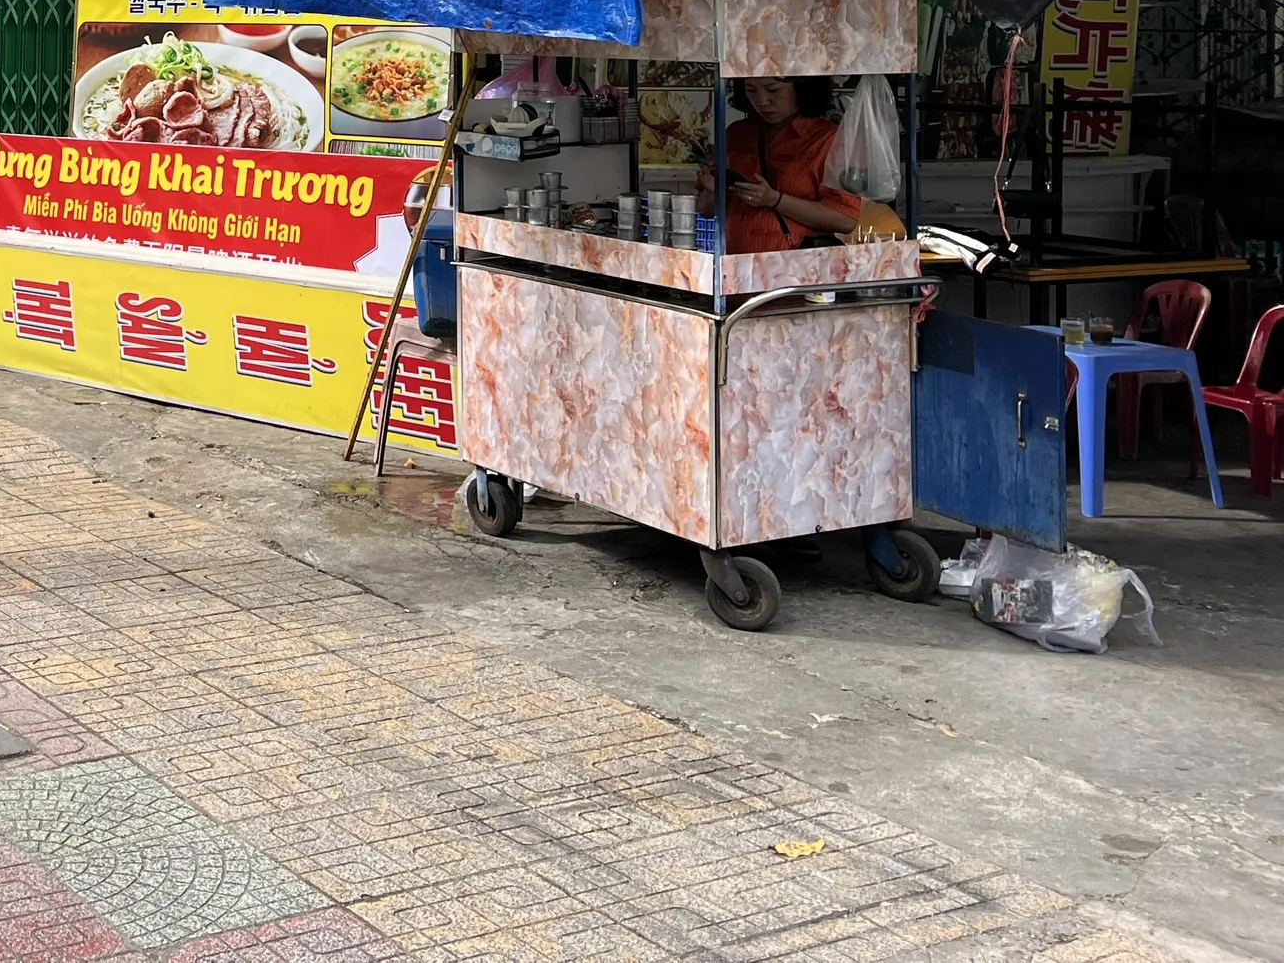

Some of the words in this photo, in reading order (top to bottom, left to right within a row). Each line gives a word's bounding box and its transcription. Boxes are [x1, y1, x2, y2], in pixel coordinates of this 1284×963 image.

[59, 146, 141, 197] Bừng
[148, 152, 225, 197] Khai
[232, 158, 375, 218] Trương
[23, 192, 59, 218] Miễn
[63, 198, 89, 221] Phí
[92, 200, 117, 224] Bia
[122, 203, 163, 234] Uống
[167, 207, 219, 241] Không
[224, 212, 260, 240] Giới
[264, 217, 301, 248] Hạn
[3, 278, 76, 351] THỊT
[116, 291, 207, 370] SẢN
[234, 315, 337, 386] HẢI
[365, 300, 458, 448] FFET
